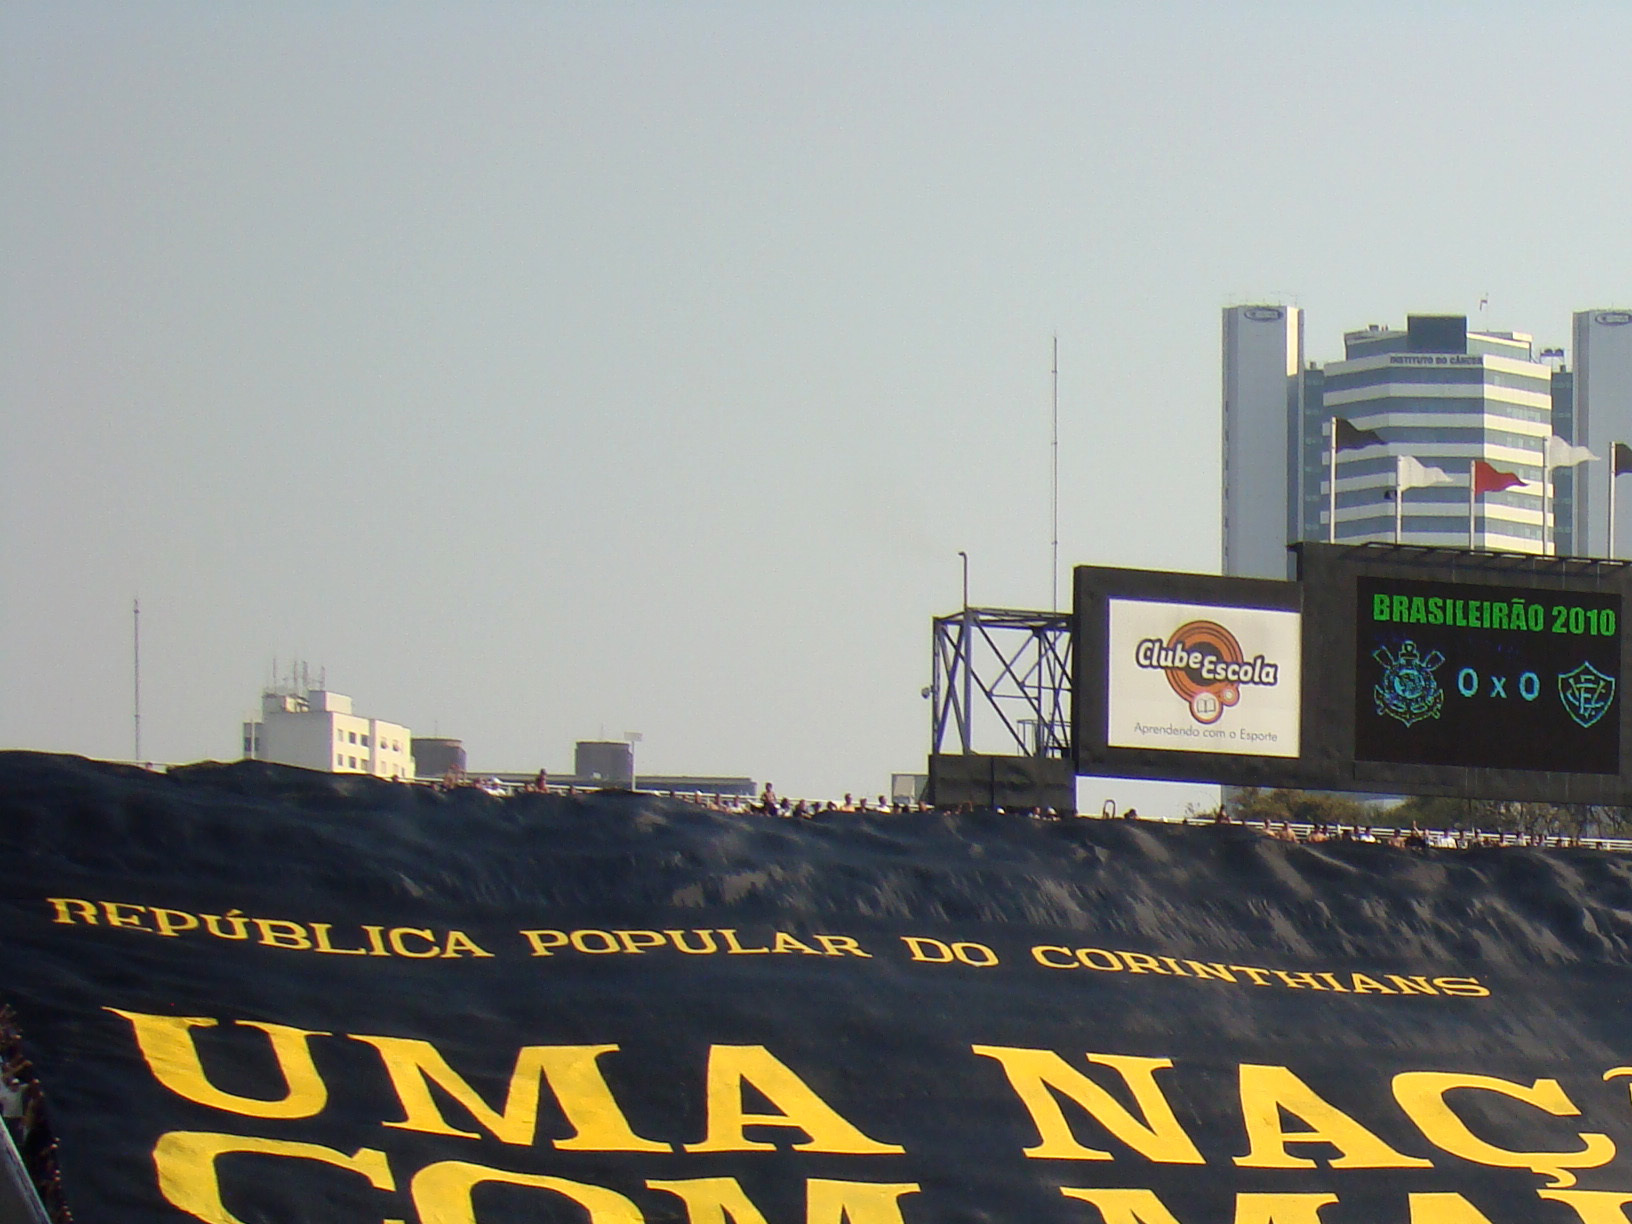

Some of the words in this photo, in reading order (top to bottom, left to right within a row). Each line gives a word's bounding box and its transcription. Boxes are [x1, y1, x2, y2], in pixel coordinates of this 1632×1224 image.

[1373, 593, 1544, 632] BRASILEIRÃO
[1551, 605, 1616, 636] 2010
[1136, 638, 1201, 670] Clube
[1201, 653, 1278, 685] Escola
[1457, 667, 1479, 697] 0
[1518, 671, 1540, 701] 0
[1134, 722, 1200, 738] Aprendendo
[1202, 729, 1225, 738] com
[1229, 731, 1236, 739] o
[1240, 728, 1278, 742] Esporte
[48, 898, 493, 958] REPÚBLICA
[521, 929, 872, 958] POPULAR
[902, 936, 999, 967] DO
[1032, 945, 1491, 997] CORINTHIANS
[106, 1006, 908, 1154] UMA
